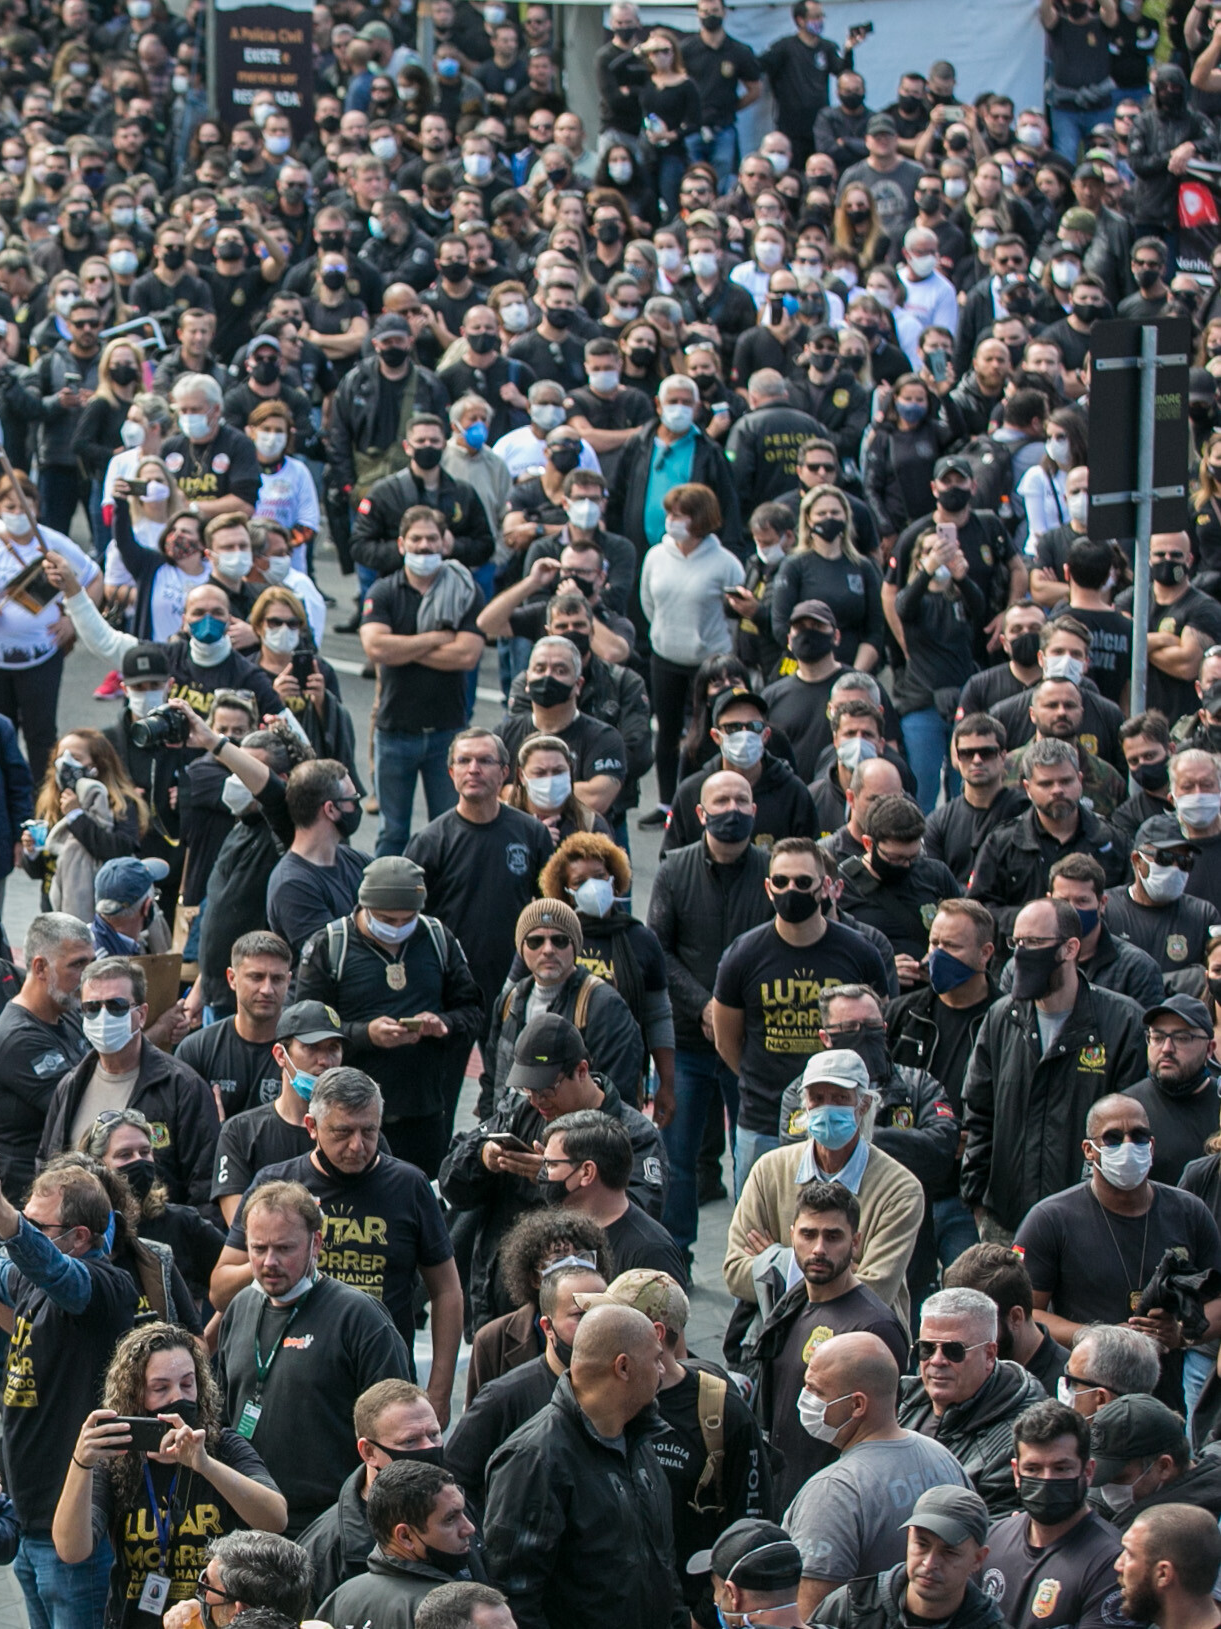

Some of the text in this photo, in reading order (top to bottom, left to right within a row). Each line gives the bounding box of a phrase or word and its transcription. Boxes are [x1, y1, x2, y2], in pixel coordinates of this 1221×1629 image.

[763, 1007, 821, 1027] MORR
[653, 1443, 691, 1461] OLÍCIA
[125, 1503, 225, 1541] LUAR
